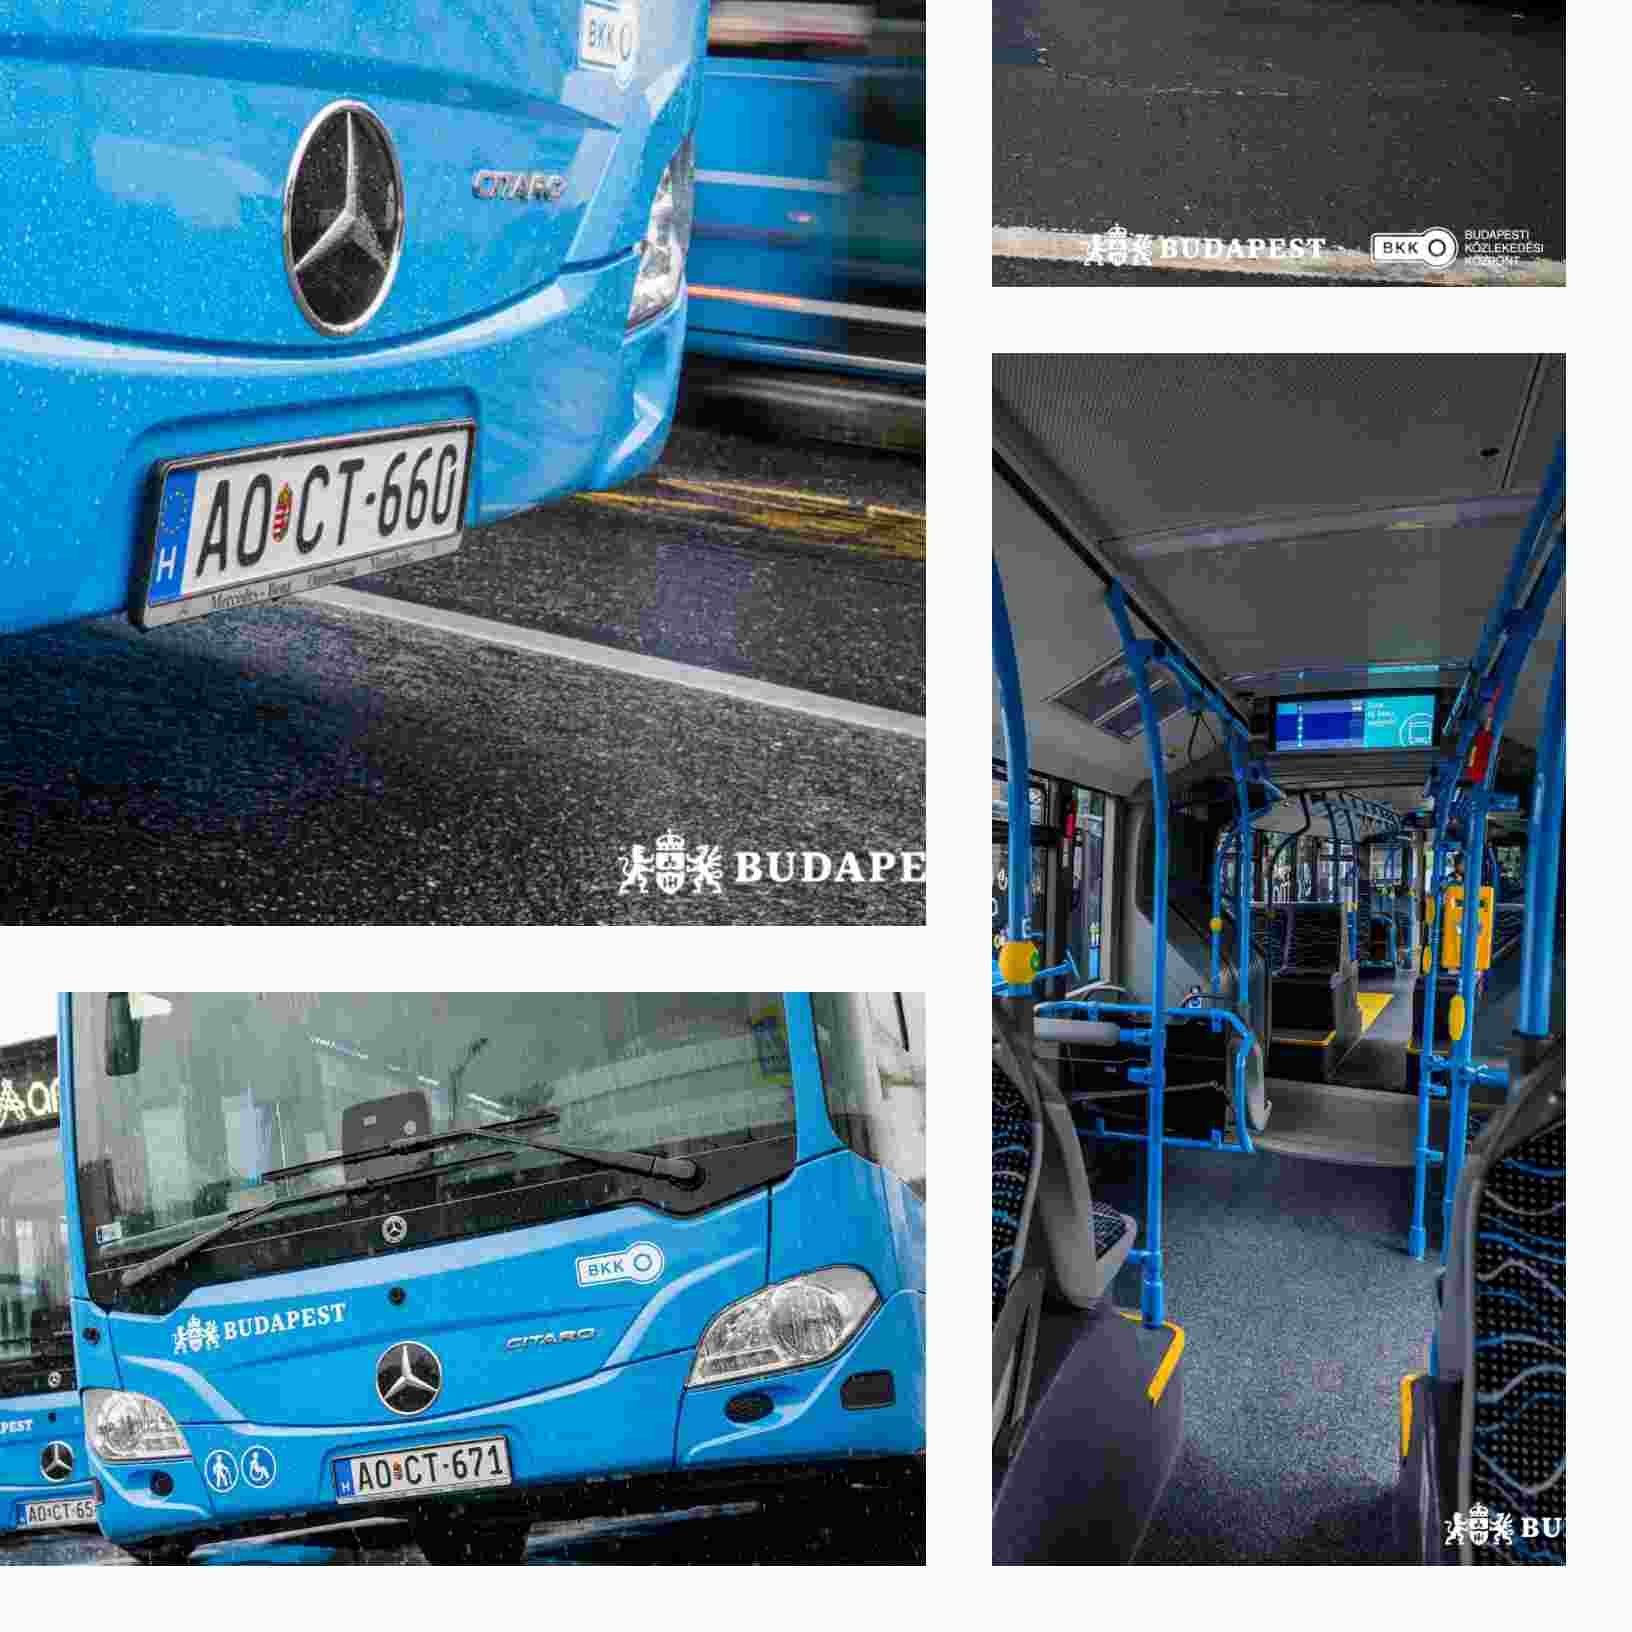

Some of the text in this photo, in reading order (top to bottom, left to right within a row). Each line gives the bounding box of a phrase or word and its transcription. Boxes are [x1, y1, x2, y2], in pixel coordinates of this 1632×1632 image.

[155, 545, 177, 583] H
[587, 1258, 625, 1278] BKK
[224, 1302, 347, 1341] BUDAPEST
[52, 1500, 97, 1521] CT-65
